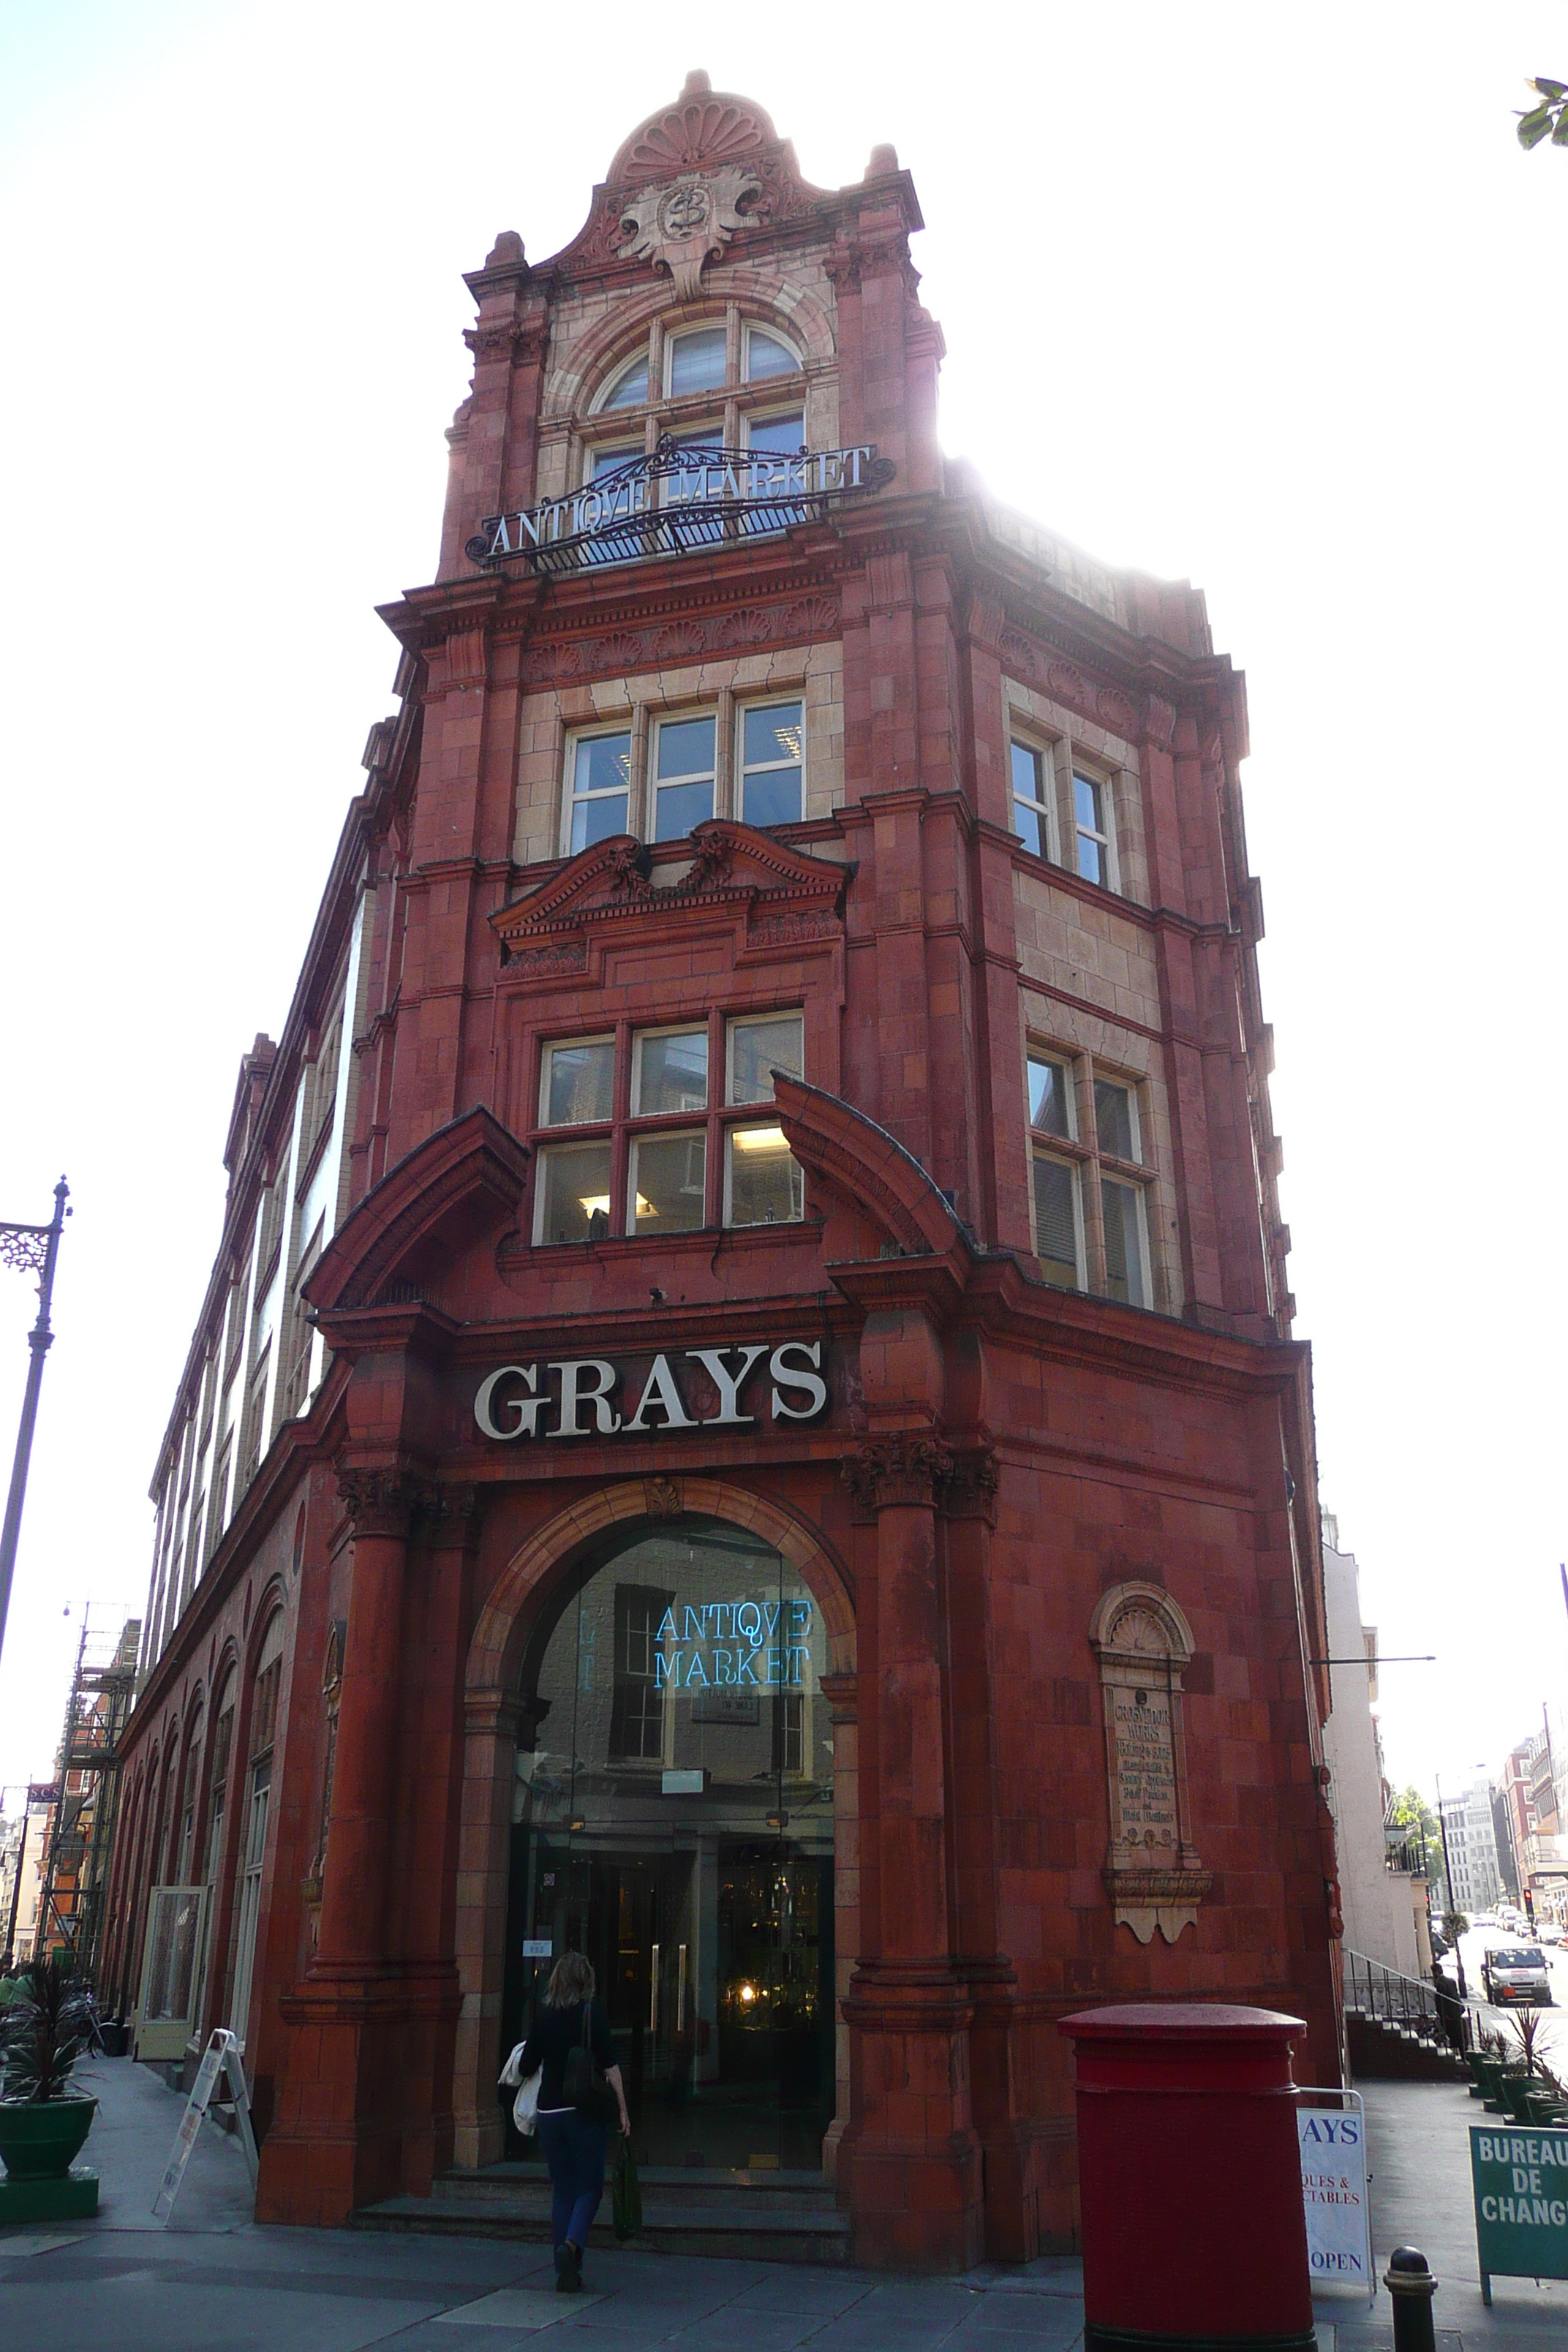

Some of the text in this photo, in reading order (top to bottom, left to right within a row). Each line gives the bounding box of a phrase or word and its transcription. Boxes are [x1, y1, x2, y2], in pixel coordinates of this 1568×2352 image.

[677, 445, 870, 504] MARKET
[474, 1341, 827, 1440] GRAYS
[653, 1646, 810, 1688] MARKET
[1478, 2136, 1568, 2166] BUREAU
[1340, 2176, 1349, 2188] &
[1512, 2168, 1542, 2195] DE
[1482, 2195, 1568, 2225] CHANG
[1311, 2252, 1362, 2271] OPEN
